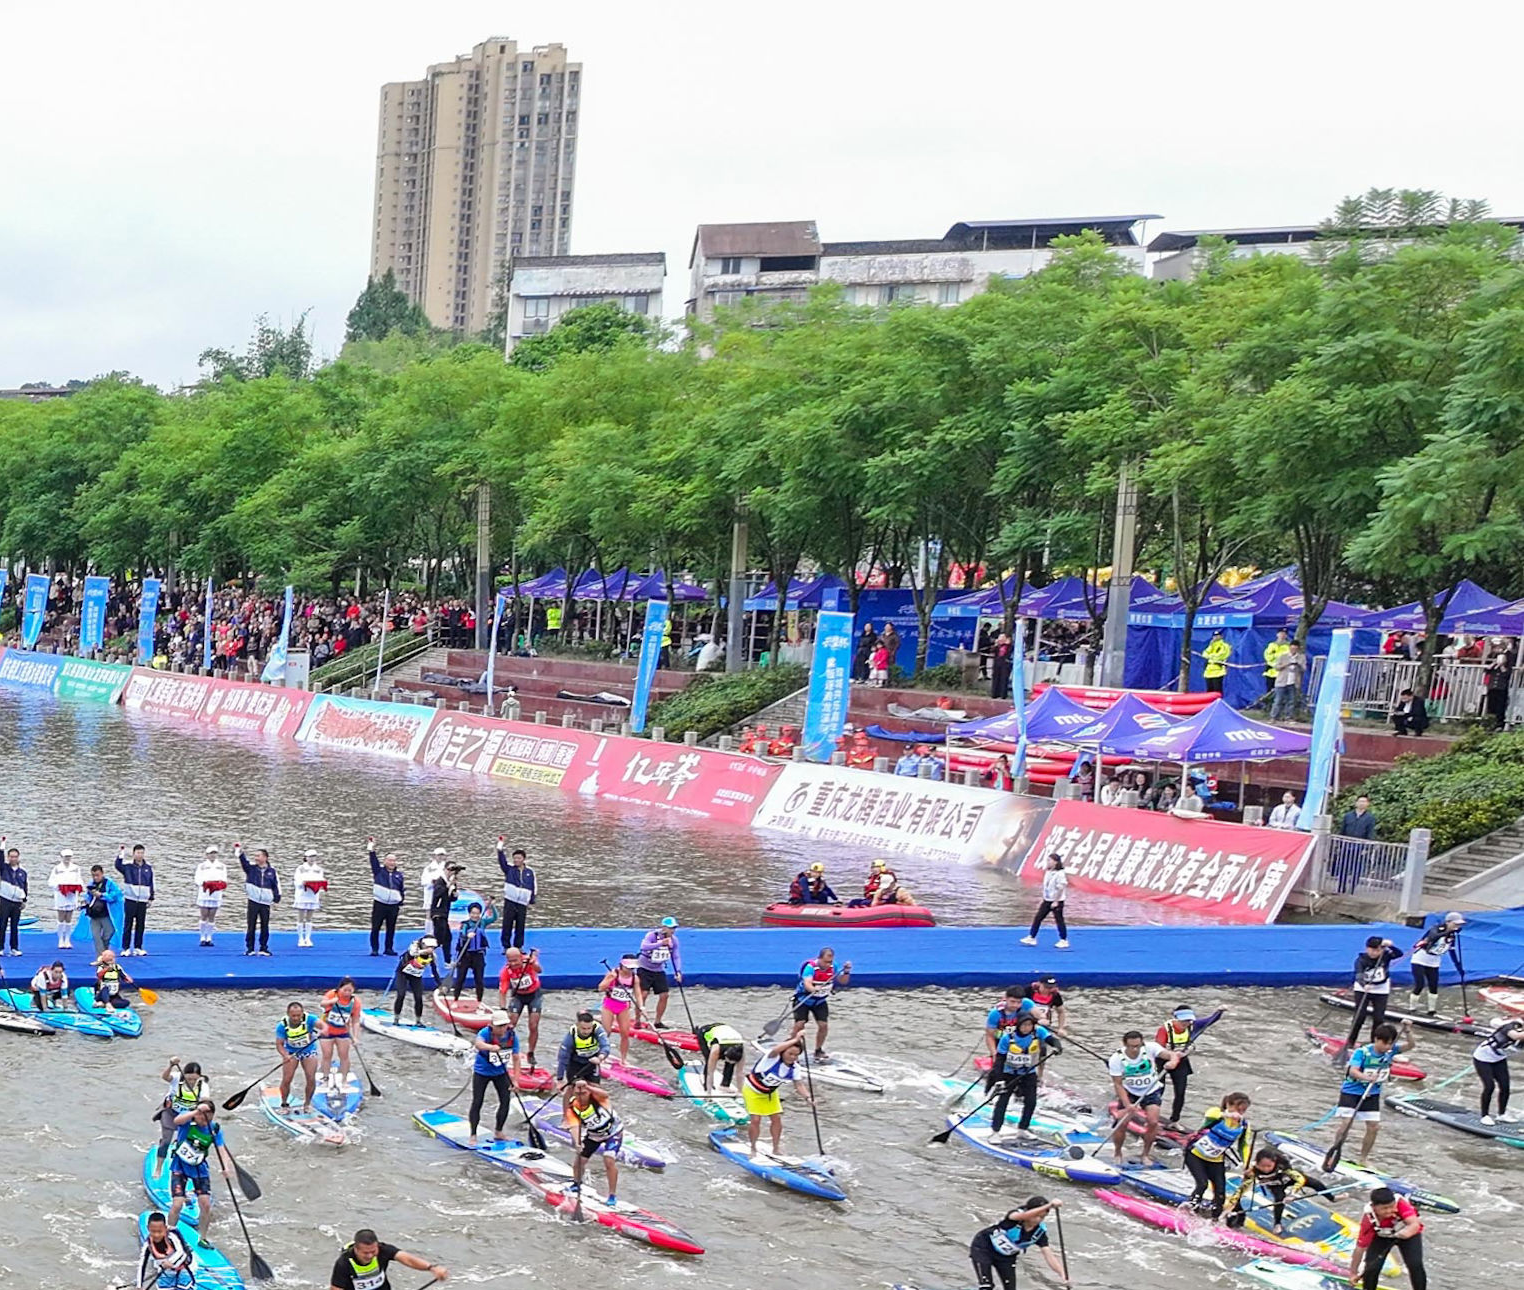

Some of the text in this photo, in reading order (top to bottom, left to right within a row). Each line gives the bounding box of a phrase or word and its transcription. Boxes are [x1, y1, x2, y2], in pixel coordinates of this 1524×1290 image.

[1053, 713, 1095, 725] mts
[1225, 729, 1275, 742] mts
[1034, 826, 1288, 910] 没有全民健康就没有全面小康
